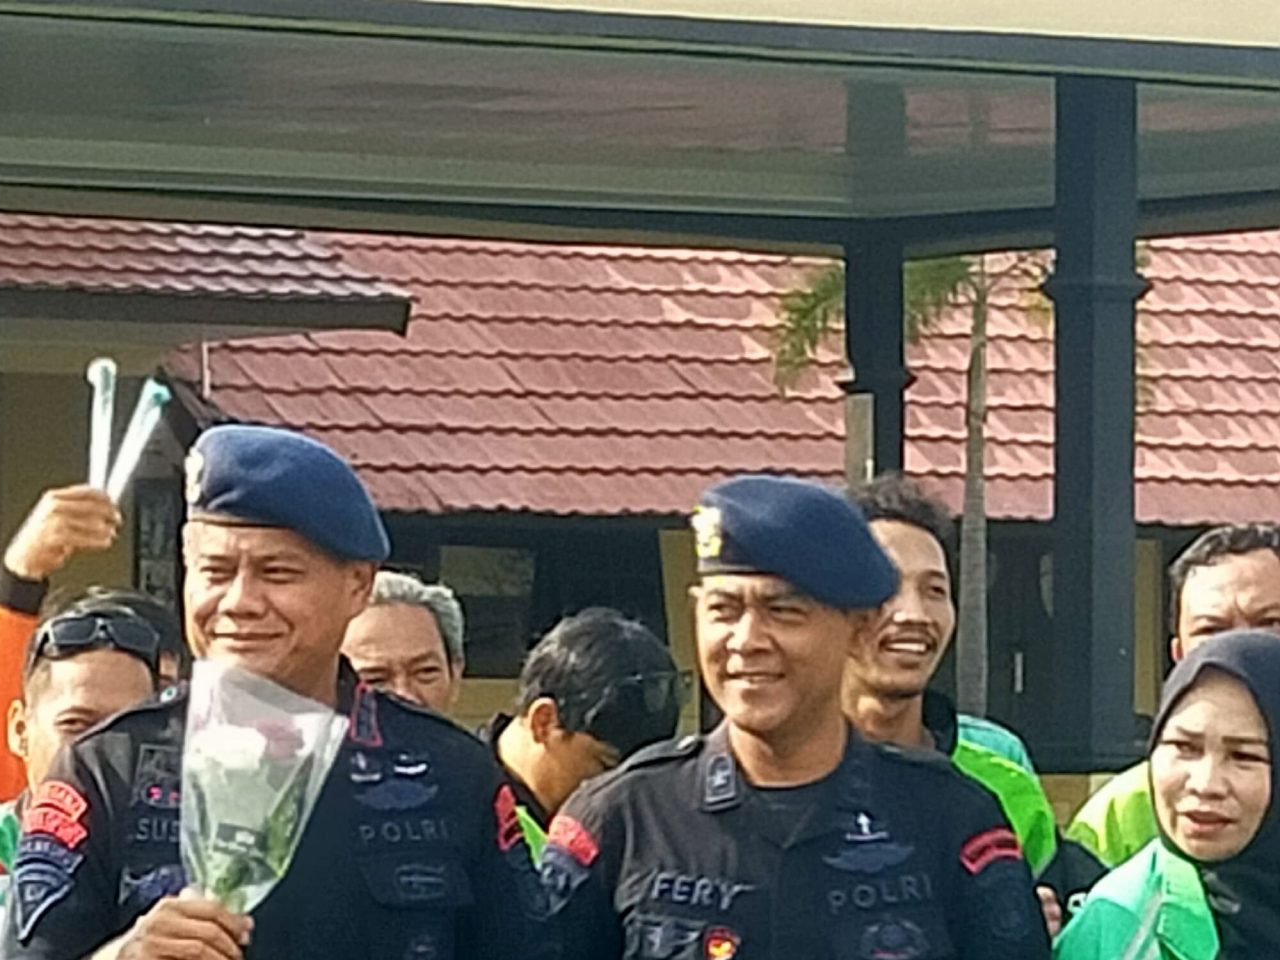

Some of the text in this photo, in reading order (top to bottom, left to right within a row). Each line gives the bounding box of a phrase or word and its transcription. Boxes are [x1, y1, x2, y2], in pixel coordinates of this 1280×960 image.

[358, 818, 449, 847] POLRI
[651, 870, 754, 911] FERY
[826, 873, 934, 915] POLRI
